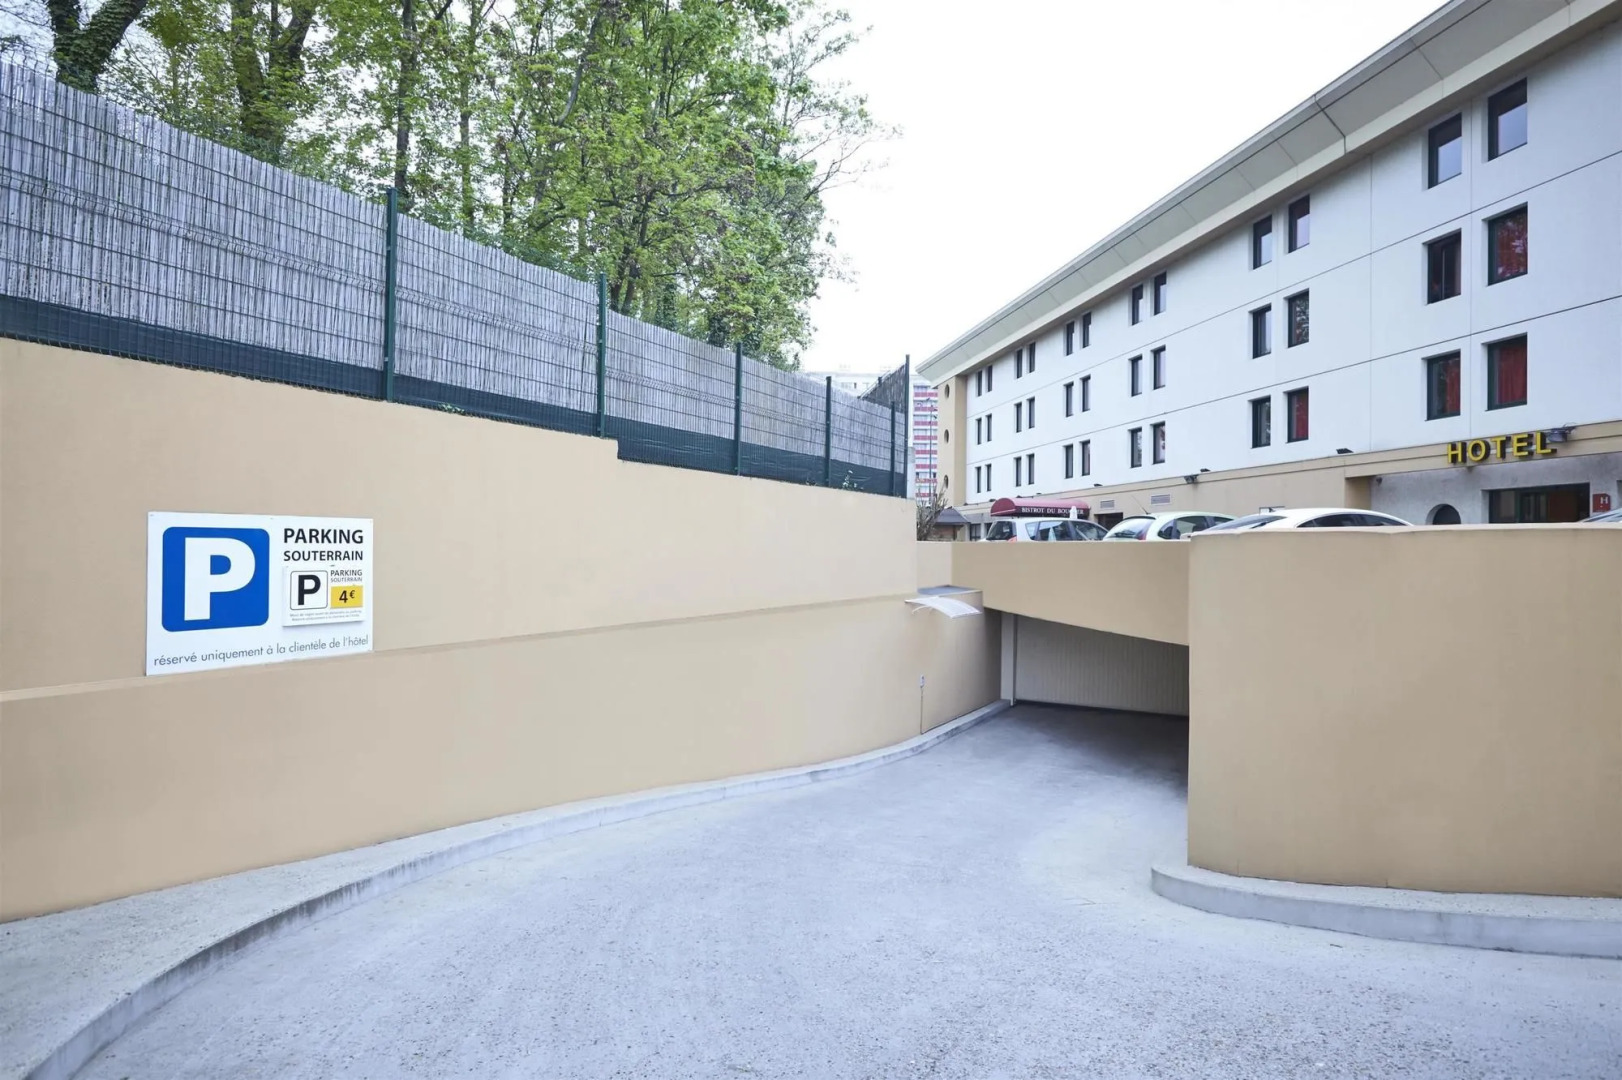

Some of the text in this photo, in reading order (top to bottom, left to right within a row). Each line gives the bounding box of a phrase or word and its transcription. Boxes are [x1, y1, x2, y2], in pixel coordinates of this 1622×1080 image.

[1447, 431, 1552, 463] HOTEL
[283, 528, 364, 544] PARKING
[283, 550, 363, 562] SOUTERRAIN
[184, 537, 256, 621] P
[330, 569, 363, 577] PARKING
[297, 574, 321, 606] P
[153, 651, 198, 666] réservé
[200, 646, 264, 662] uniquement
[266, 645, 274, 655] à
[276, 642, 286, 654] la
[288, 638, 327, 653] clientèle
[328, 637, 341, 649] de
